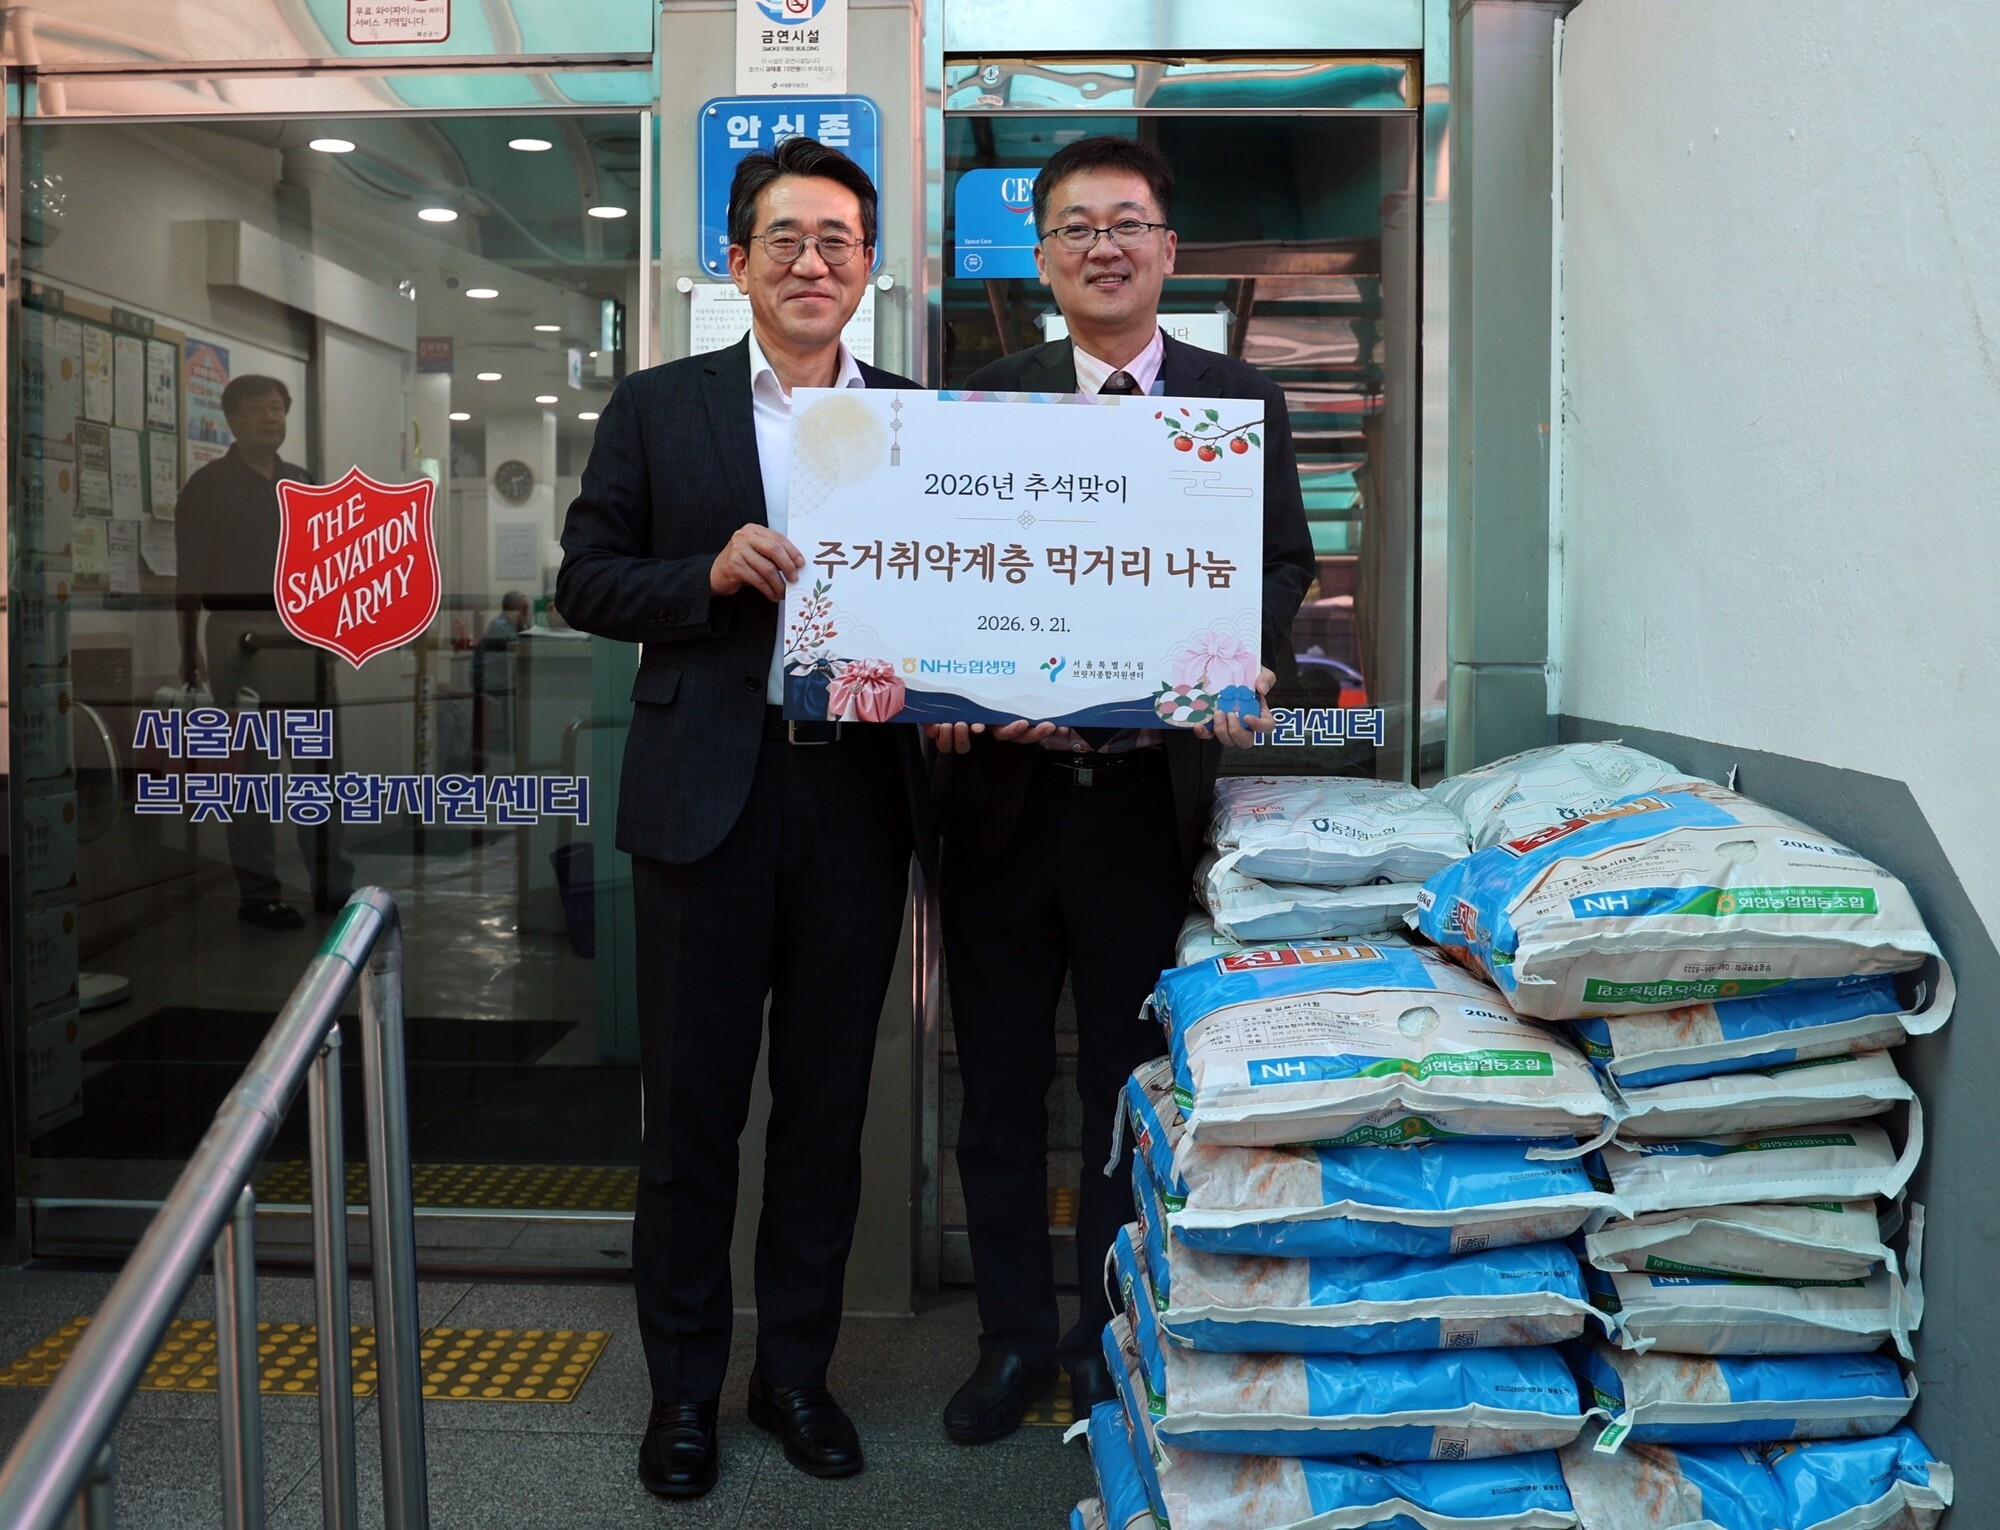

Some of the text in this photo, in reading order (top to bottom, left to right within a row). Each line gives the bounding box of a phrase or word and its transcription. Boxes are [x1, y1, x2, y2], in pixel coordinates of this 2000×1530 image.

[375, 6, 410, 16] 와이파이
[353, 17, 428, 27] 서비스 지역입니다.
[761, 30, 820, 44] 금연시설
[924, 472, 1128, 503] 2026년 추석맞이
[307, 492, 366, 552] THE
[287, 501, 418, 614] SALVATION
[812, 540, 1237, 589] 주거취약계층 먹거리 나눔
[334, 554, 415, 638] ARMY
[976, 615, 1071, 633] 2026. 9. 21.
[920, 659, 1016, 675] NH농협생명
[1072, 670, 1145, 681] 브릿지종합지원센터
[132, 707, 334, 760] 서울시립
[1253, 707, 1385, 747] 원센터
[134, 771, 591, 825] 브릿지종합지원센터
[1780, 839, 1825, 853] 20kg
[1583, 895, 1629, 912] NH
[1465, 1008, 1508, 1021] 20kg
[1261, 1061, 1306, 1079] NH
